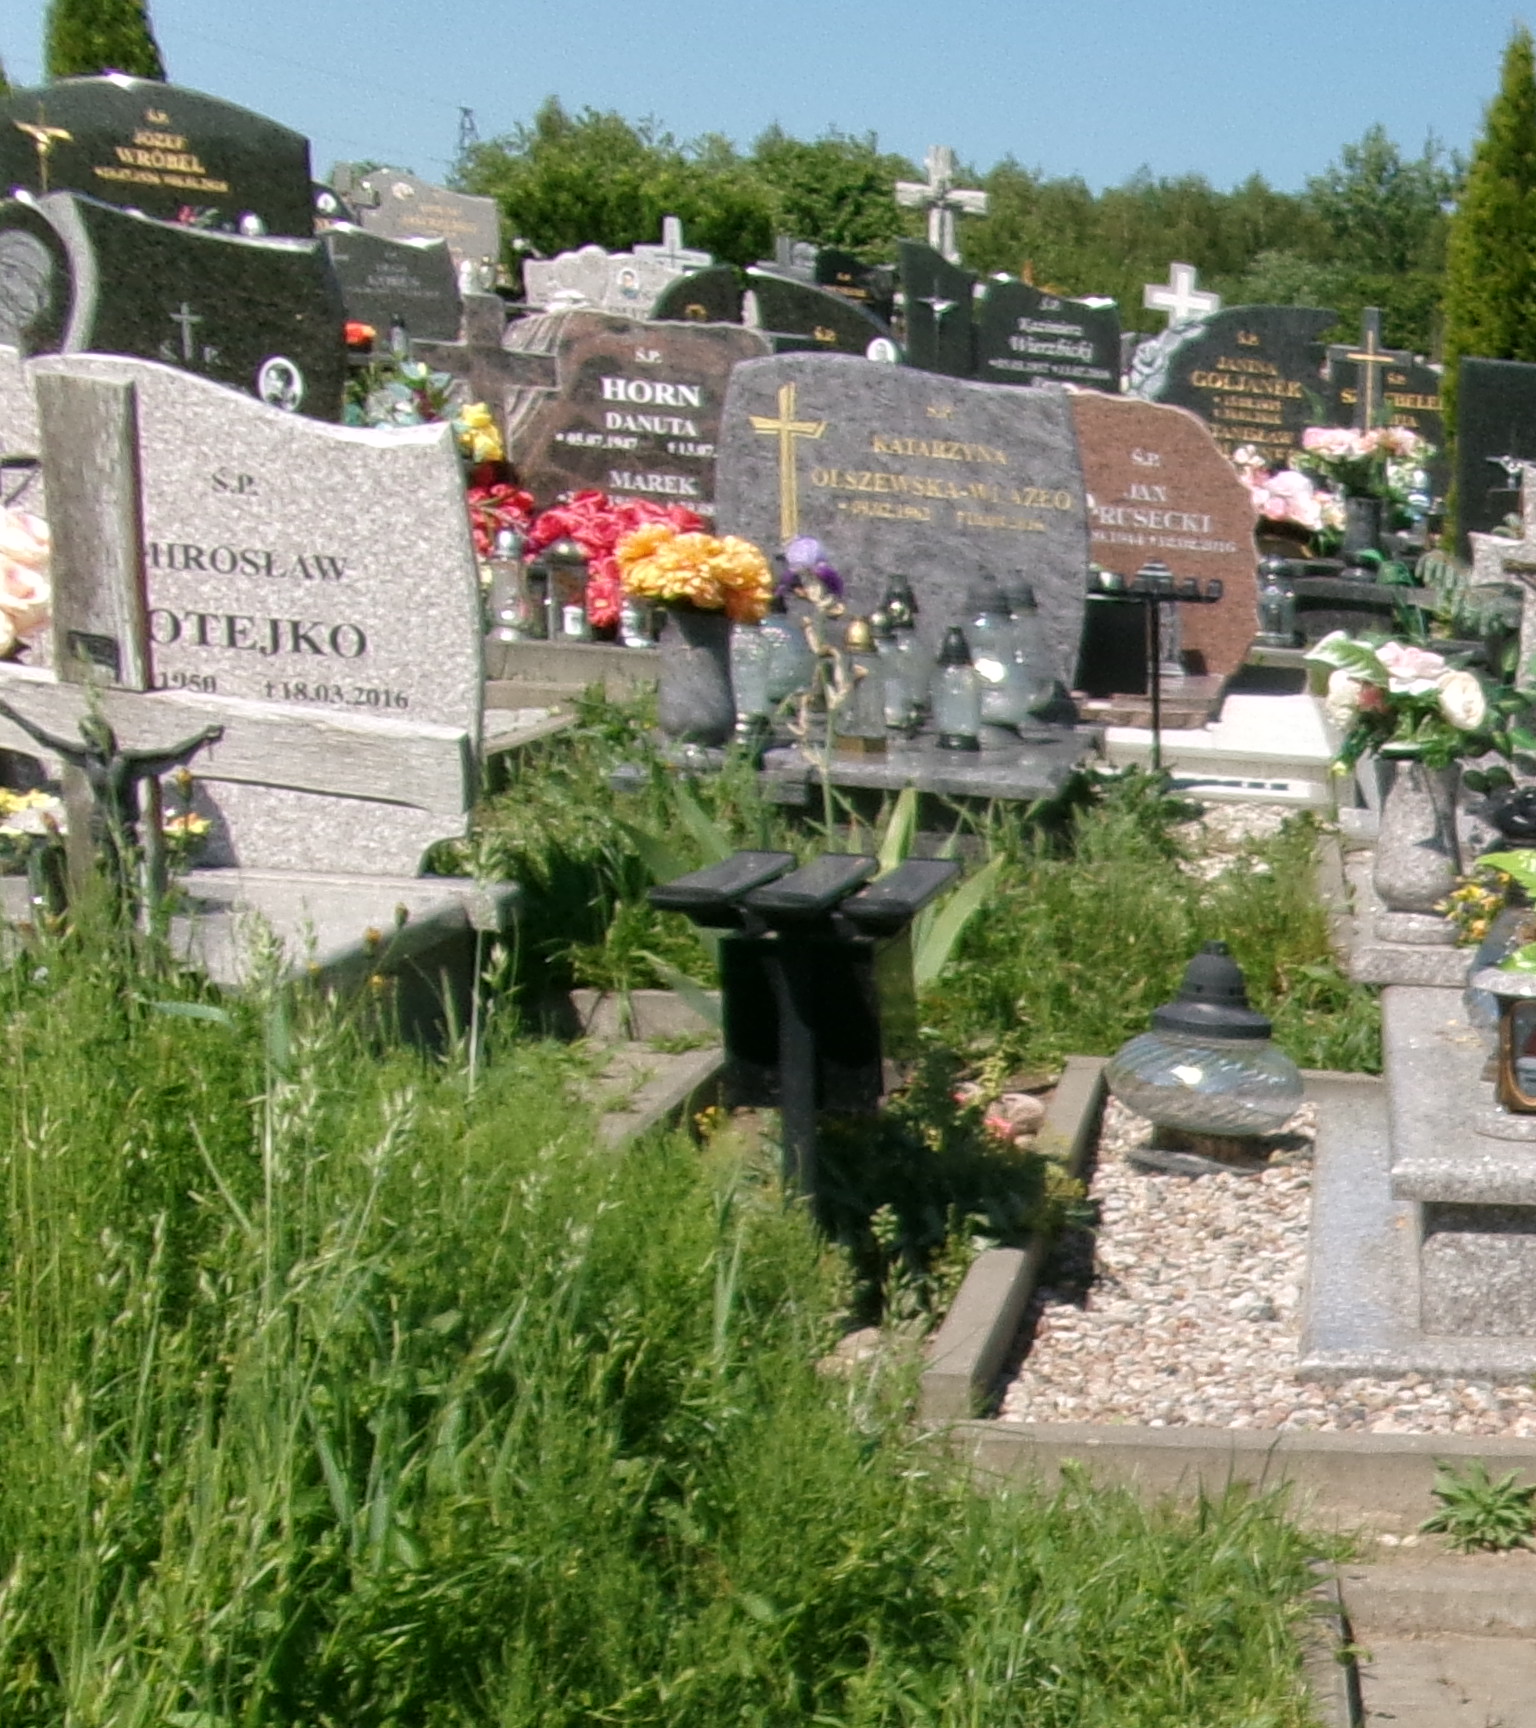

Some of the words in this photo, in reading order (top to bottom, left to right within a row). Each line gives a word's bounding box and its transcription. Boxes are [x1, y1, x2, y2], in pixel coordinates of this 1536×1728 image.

[601, 376, 701, 408] HORN
[606, 411, 697, 437] DANUTA
[609, 470, 698, 496] MAREK
[146, 541, 348, 581] IROSŁAW
[148, 608, 368, 659] OTEJKO
